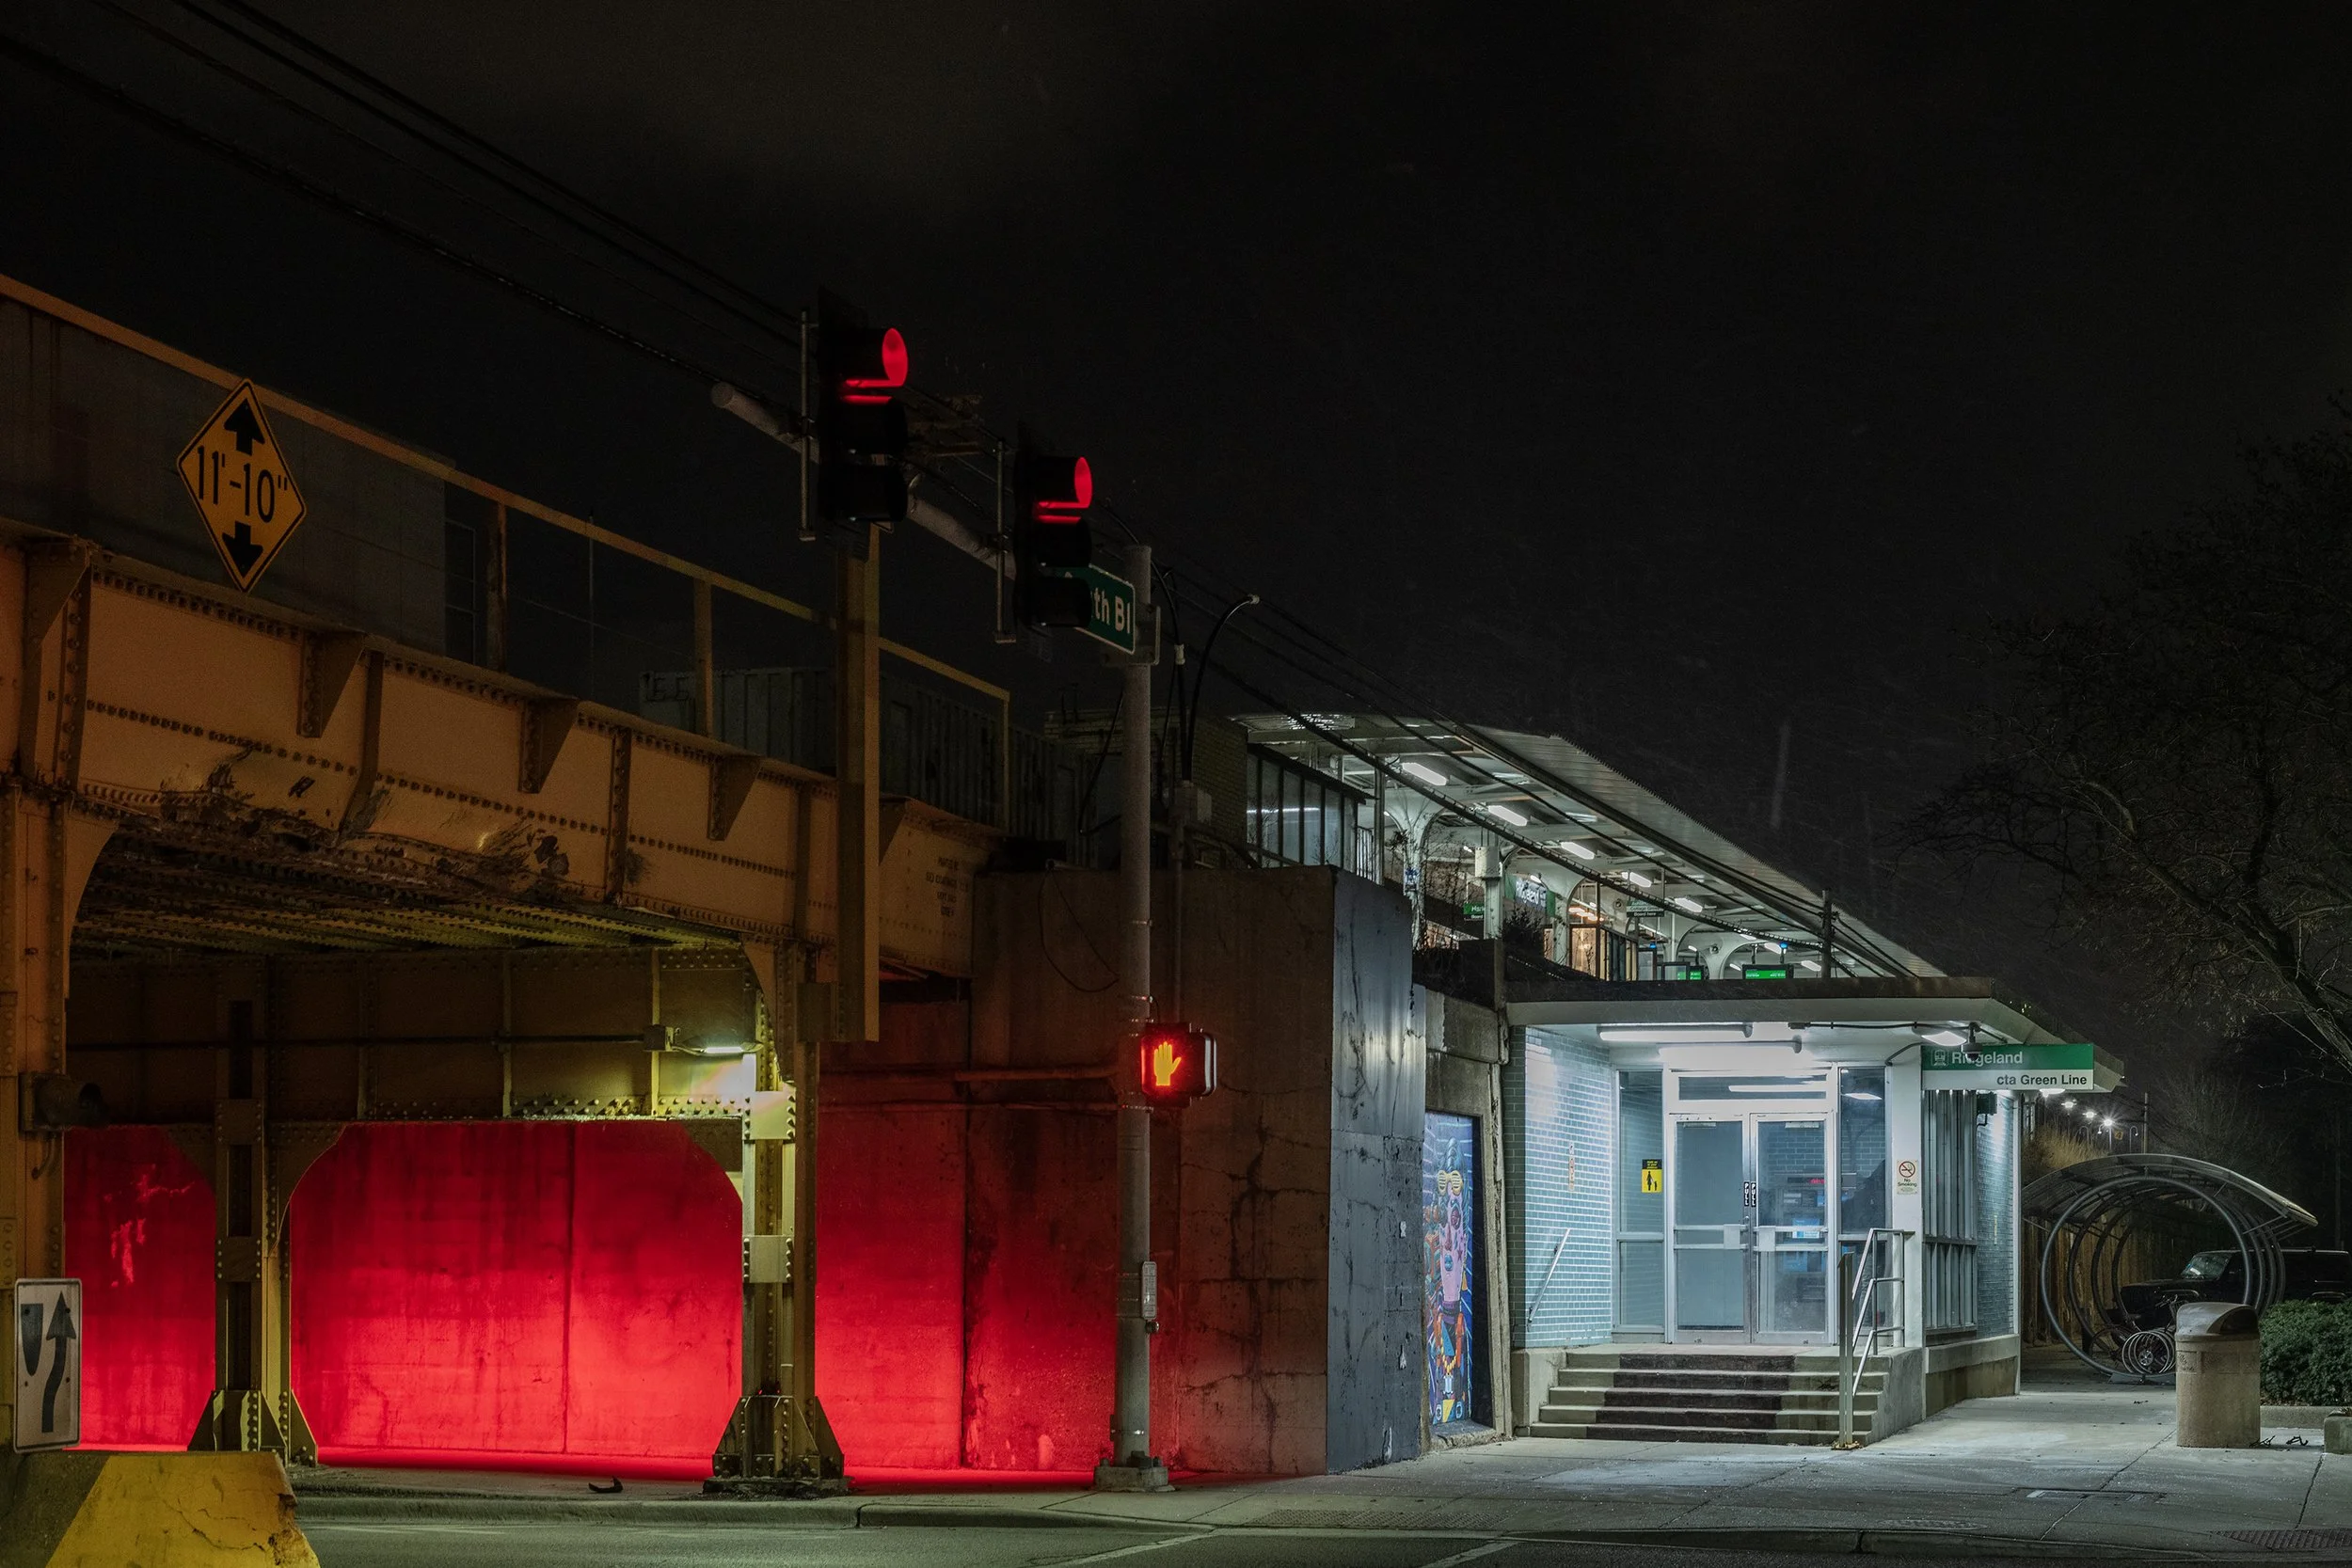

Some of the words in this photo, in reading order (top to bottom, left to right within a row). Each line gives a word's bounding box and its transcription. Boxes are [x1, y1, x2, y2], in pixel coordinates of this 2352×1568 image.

[1114, 595, 1131, 634] Bl
[1951, 1052, 2023, 1067] Rigeland
[1996, 1075, 2017, 1085] cta
[2020, 1074, 2058, 1085] Green
[2061, 1074, 2087, 1085] Line
